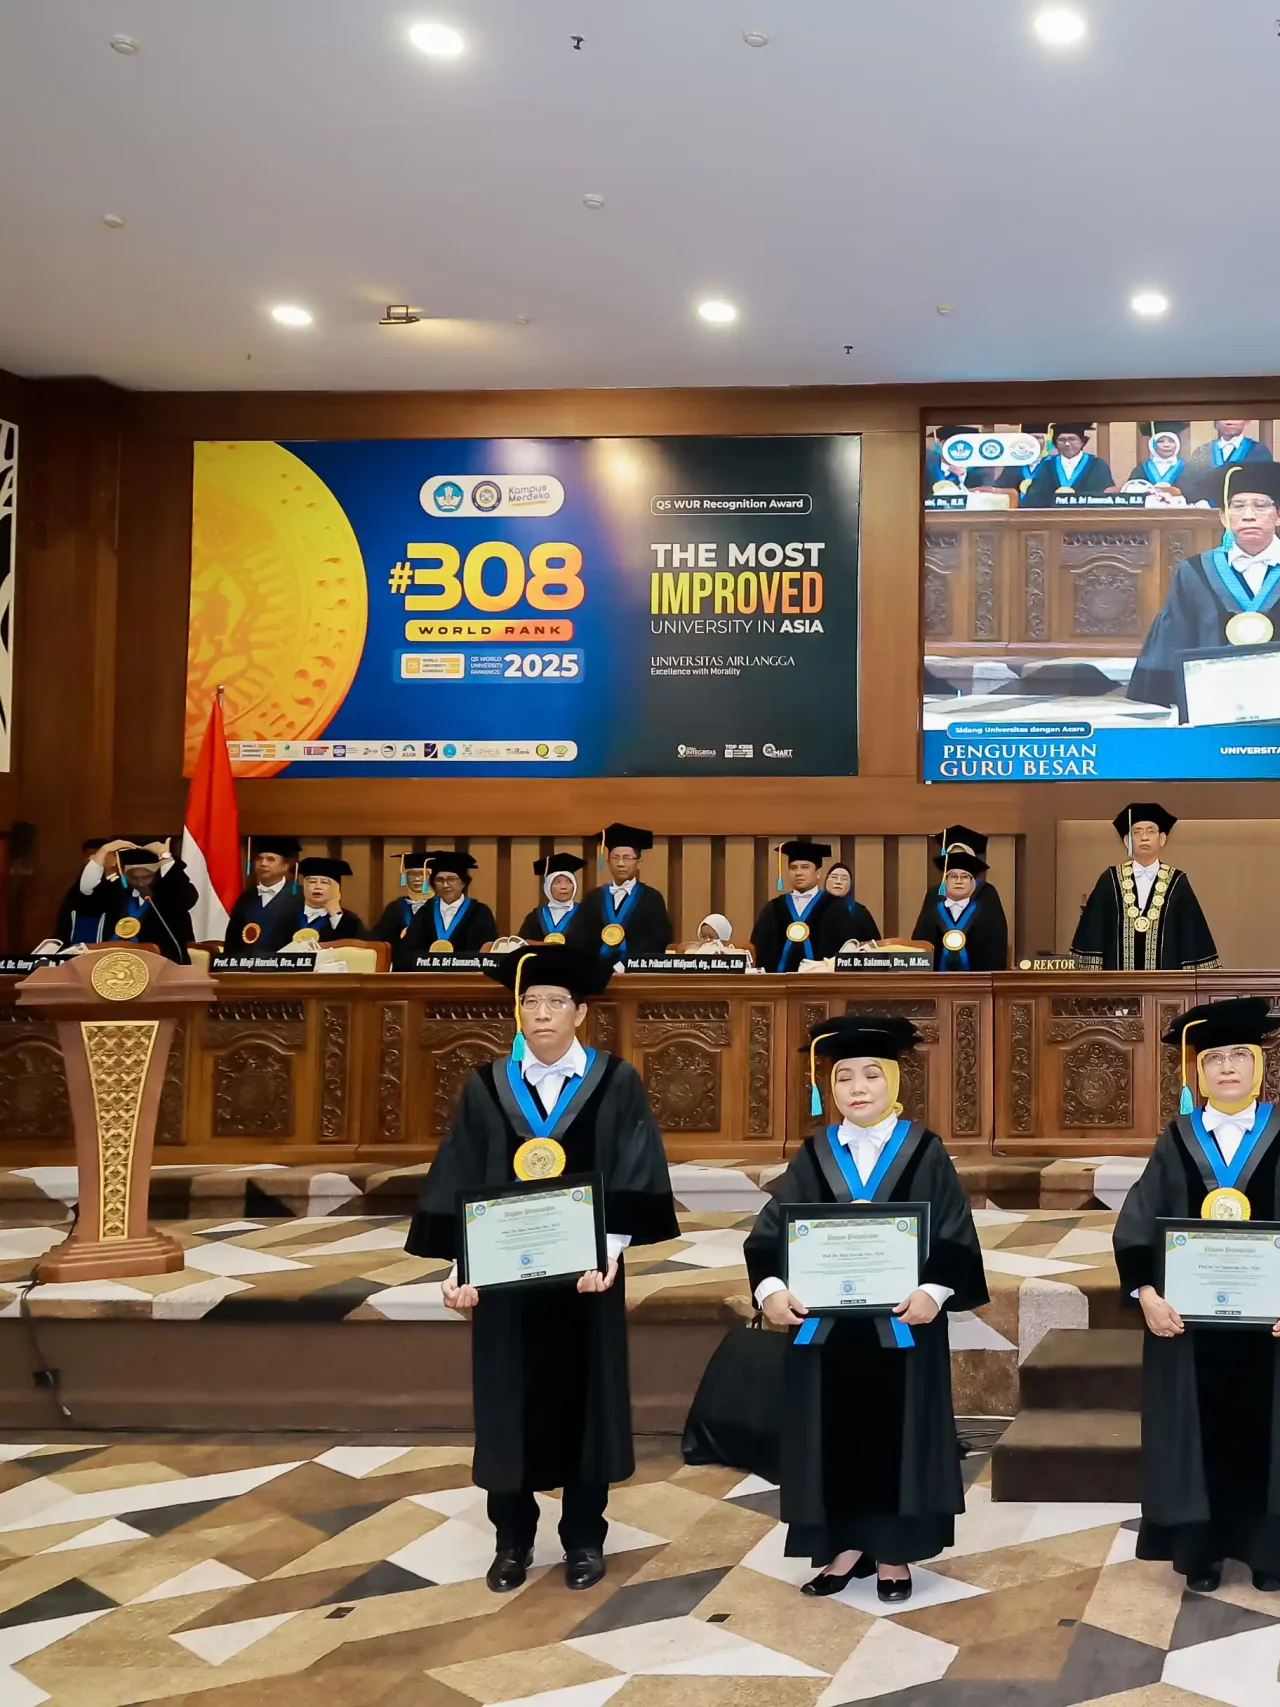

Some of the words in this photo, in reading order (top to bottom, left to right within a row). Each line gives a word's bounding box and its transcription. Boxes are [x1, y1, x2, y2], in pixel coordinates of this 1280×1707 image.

[508, 484, 547, 496] Kampus
[508, 492, 550, 502] Merdeka
[656, 500, 671, 510] QS
[674, 500, 700, 508] WUR
[703, 498, 766, 510] Recognition
[768, 498, 804, 508] Award
[650, 543, 718, 568] THE
[728, 542, 826, 567] MOST
[388, 541, 585, 612] #308
[650, 571, 824, 615] IMPROVED
[418, 626, 492, 635] WORLD
[504, 626, 560, 634] RANK
[650, 620, 753, 634] UNIVERSITY
[757, 620, 775, 634] IN
[780, 619, 824, 634] ASIA
[504, 653, 579, 678] 2025
[650, 656, 724, 667] UNIVERSITAS
[726, 656, 796, 666] AIRLANGGA
[650, 668, 691, 676] Excellence
[692, 668, 709, 676] with
[710, 668, 740, 676] Morality
[1030, 726, 1060, 734] dengan
[943, 744, 1097, 758] PENGUKUHAN
[940, 760, 1014, 776] GURU
[1023, 760, 1098, 776] BESAR
[213, 958, 228, 967] Prof.
[230, 958, 238, 966] Dr.
[297, 958, 312, 966] M.Si.
[416, 957, 430, 966] Prof.
[432, 957, 440, 966] Dr.
[442, 957, 450, 966] Sri
[628, 959, 639, 968] Prof.
[837, 958, 852, 966] Prof.
[854, 958, 862, 966] Dr.
[864, 958, 892, 968] Salamun,
[894, 958, 908, 967] Drs.,
[909, 958, 930, 966] M.Kes.
[1033, 959, 1076, 970] REKTOR
